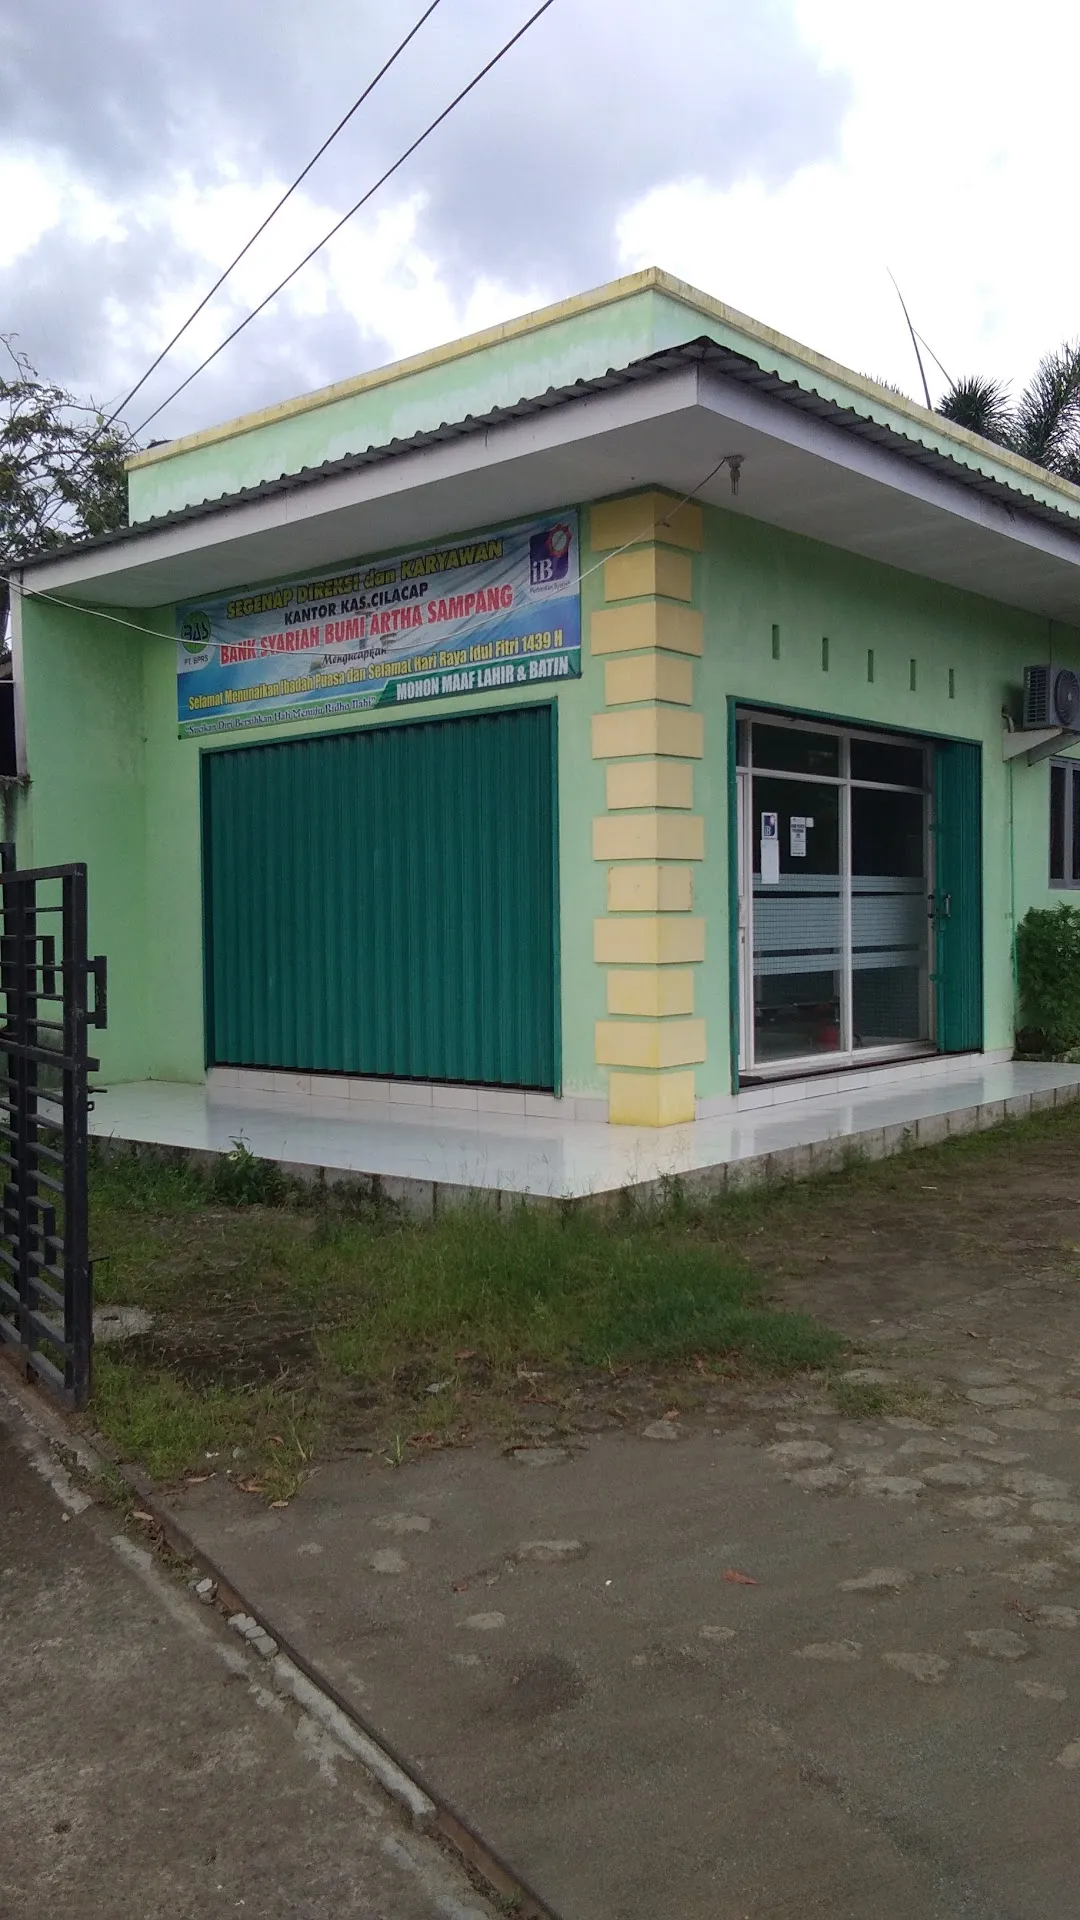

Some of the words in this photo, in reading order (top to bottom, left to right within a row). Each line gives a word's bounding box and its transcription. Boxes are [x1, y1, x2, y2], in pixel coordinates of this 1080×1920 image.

[227, 588, 293, 620] SEGENAP
[296, 573, 360, 605] DIREKSI
[363, 568, 397, 590] dan
[400, 539, 504, 581] KARYAWAN
[531, 558, 553, 583] iB
[220, 638, 257, 665] BANK
[260, 626, 320, 657] SYARIAH
[324, 617, 365, 644] BUMI
[369, 604, 423, 636] ARTHA
[427, 584, 513, 624] SAMPANG
[284, 606, 336, 625] KANTOR
[188, 692, 223, 711] Selamat
[224, 682, 279, 705] Menunaikan
[280, 674, 314, 696] Ibadah
[315, 671, 345, 689] Puasa
[346, 667, 366, 683] dan
[368, 658, 412, 680] Selamat
[413, 651, 438, 672] Hari
[439, 648, 467, 668] Raya
[469, 642, 493, 662] Idul
[495, 636, 519, 658] Fitri
[521, 631, 552, 653] 1439
[554, 629, 563, 648] H
[321, 647, 387, 666] Mengucapkan
[396, 677, 439, 701] MOHON
[441, 671, 475, 693] MAAF
[477, 663, 514, 688] LAHIR
[517, 668, 527, 681] &
[529, 655, 569, 680] BATIN
